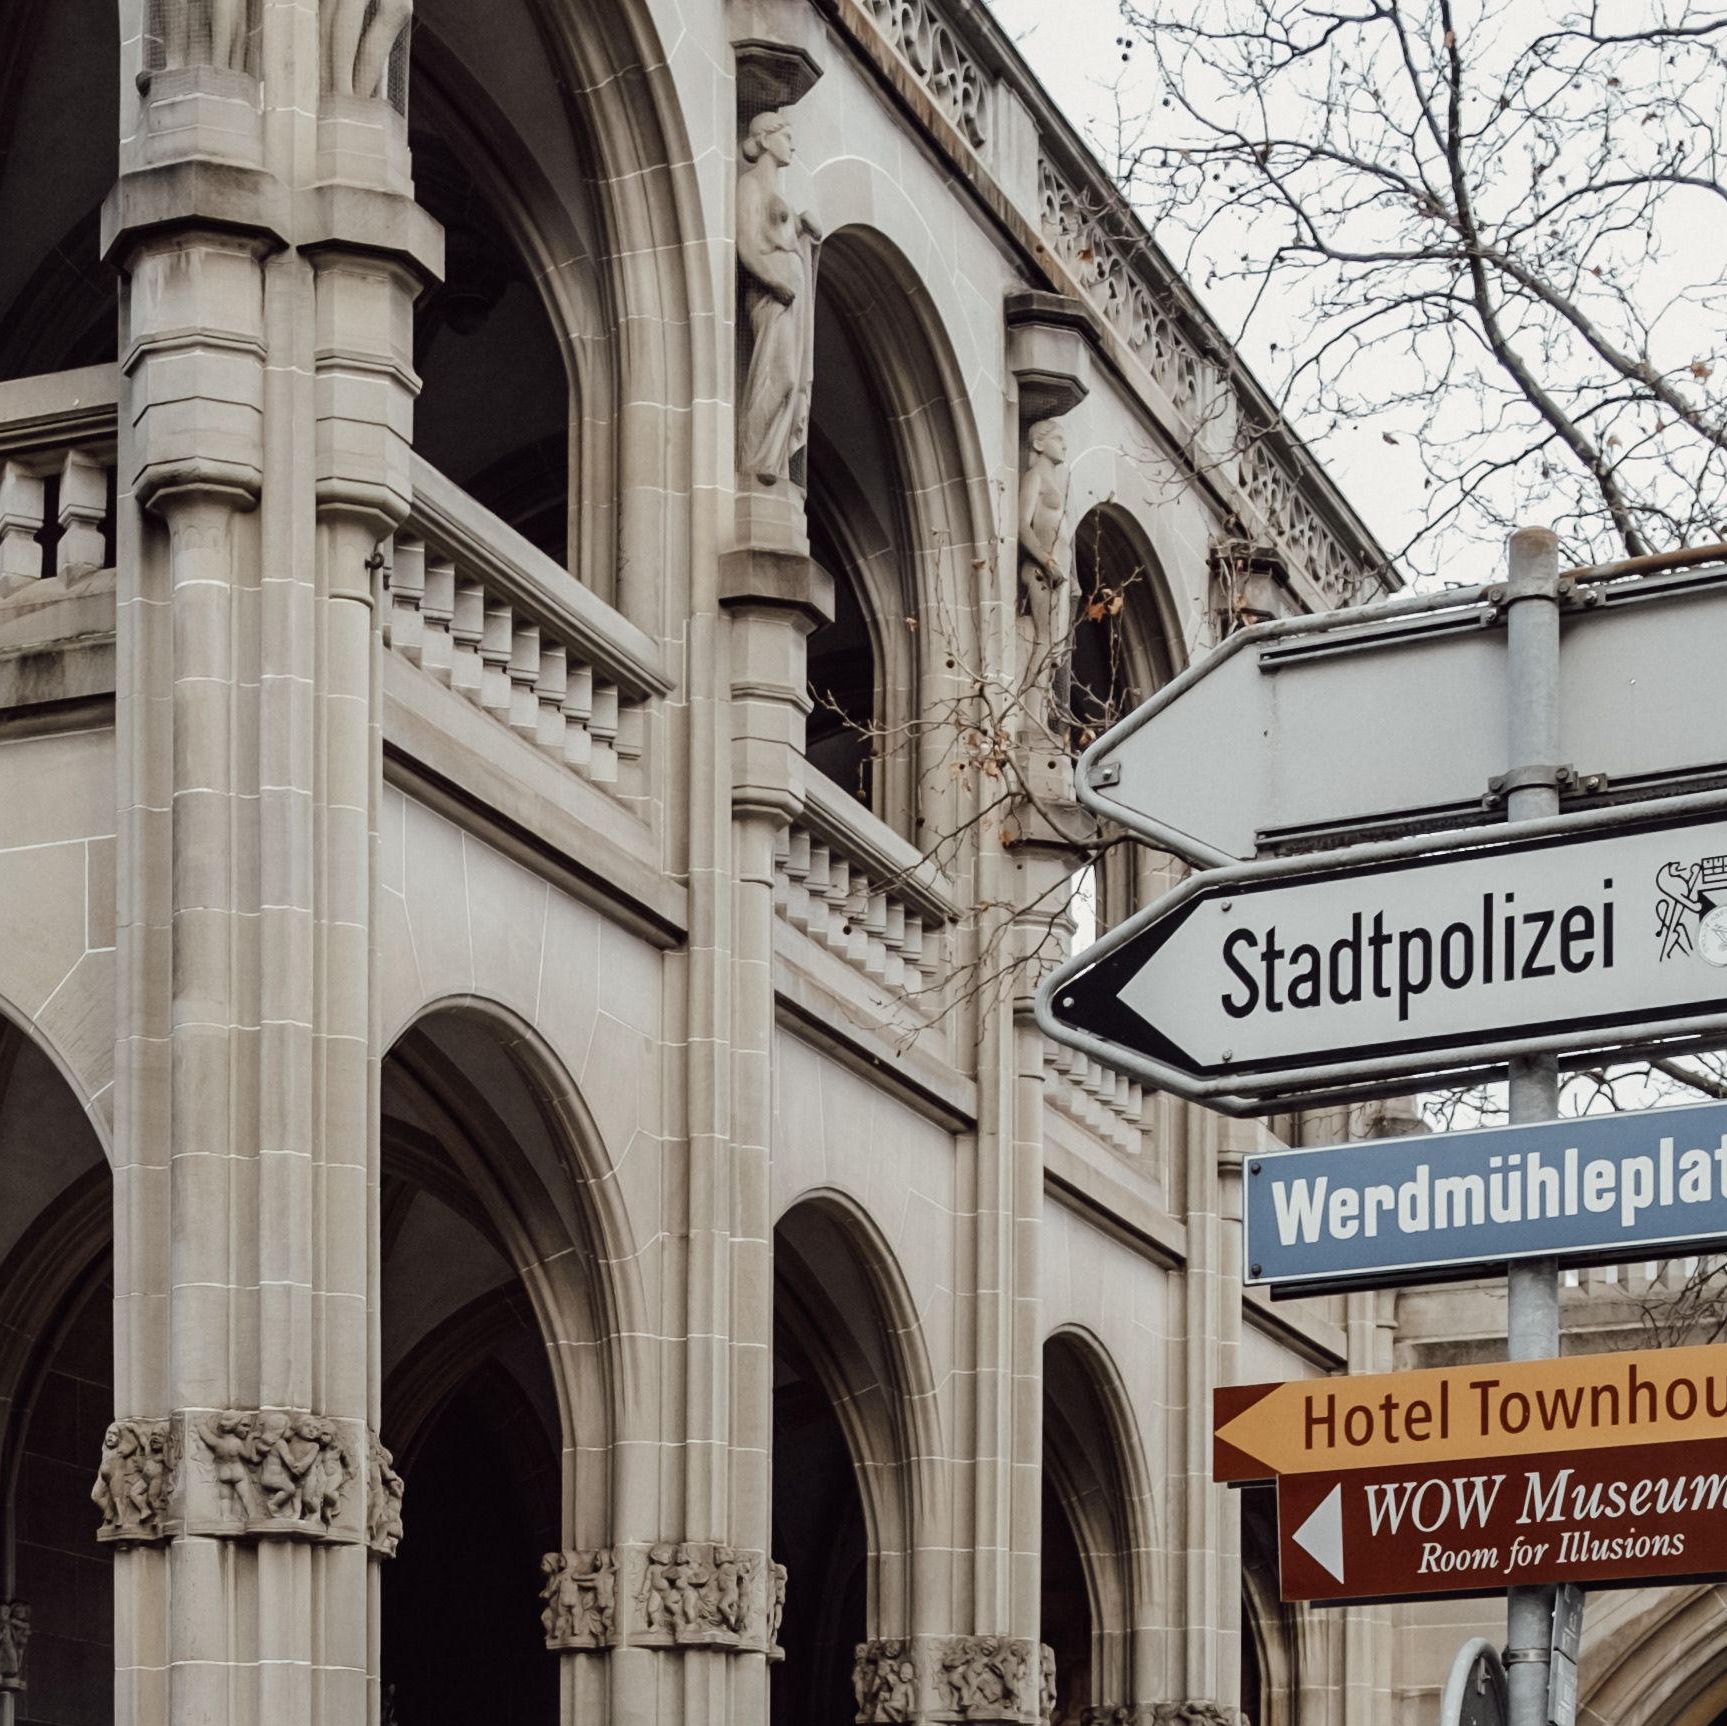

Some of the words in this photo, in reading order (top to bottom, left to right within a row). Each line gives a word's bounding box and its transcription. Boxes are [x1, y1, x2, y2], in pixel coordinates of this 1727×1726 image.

[1221, 879, 1614, 1021] Stadtpolizei
[1304, 1380, 1449, 1451] Hotel
[1364, 1474, 1506, 1537] WOW
[1417, 1542, 1499, 1574] Room
[1504, 1536, 1549, 1574] for
[1556, 1529, 1685, 1564] Illusions
